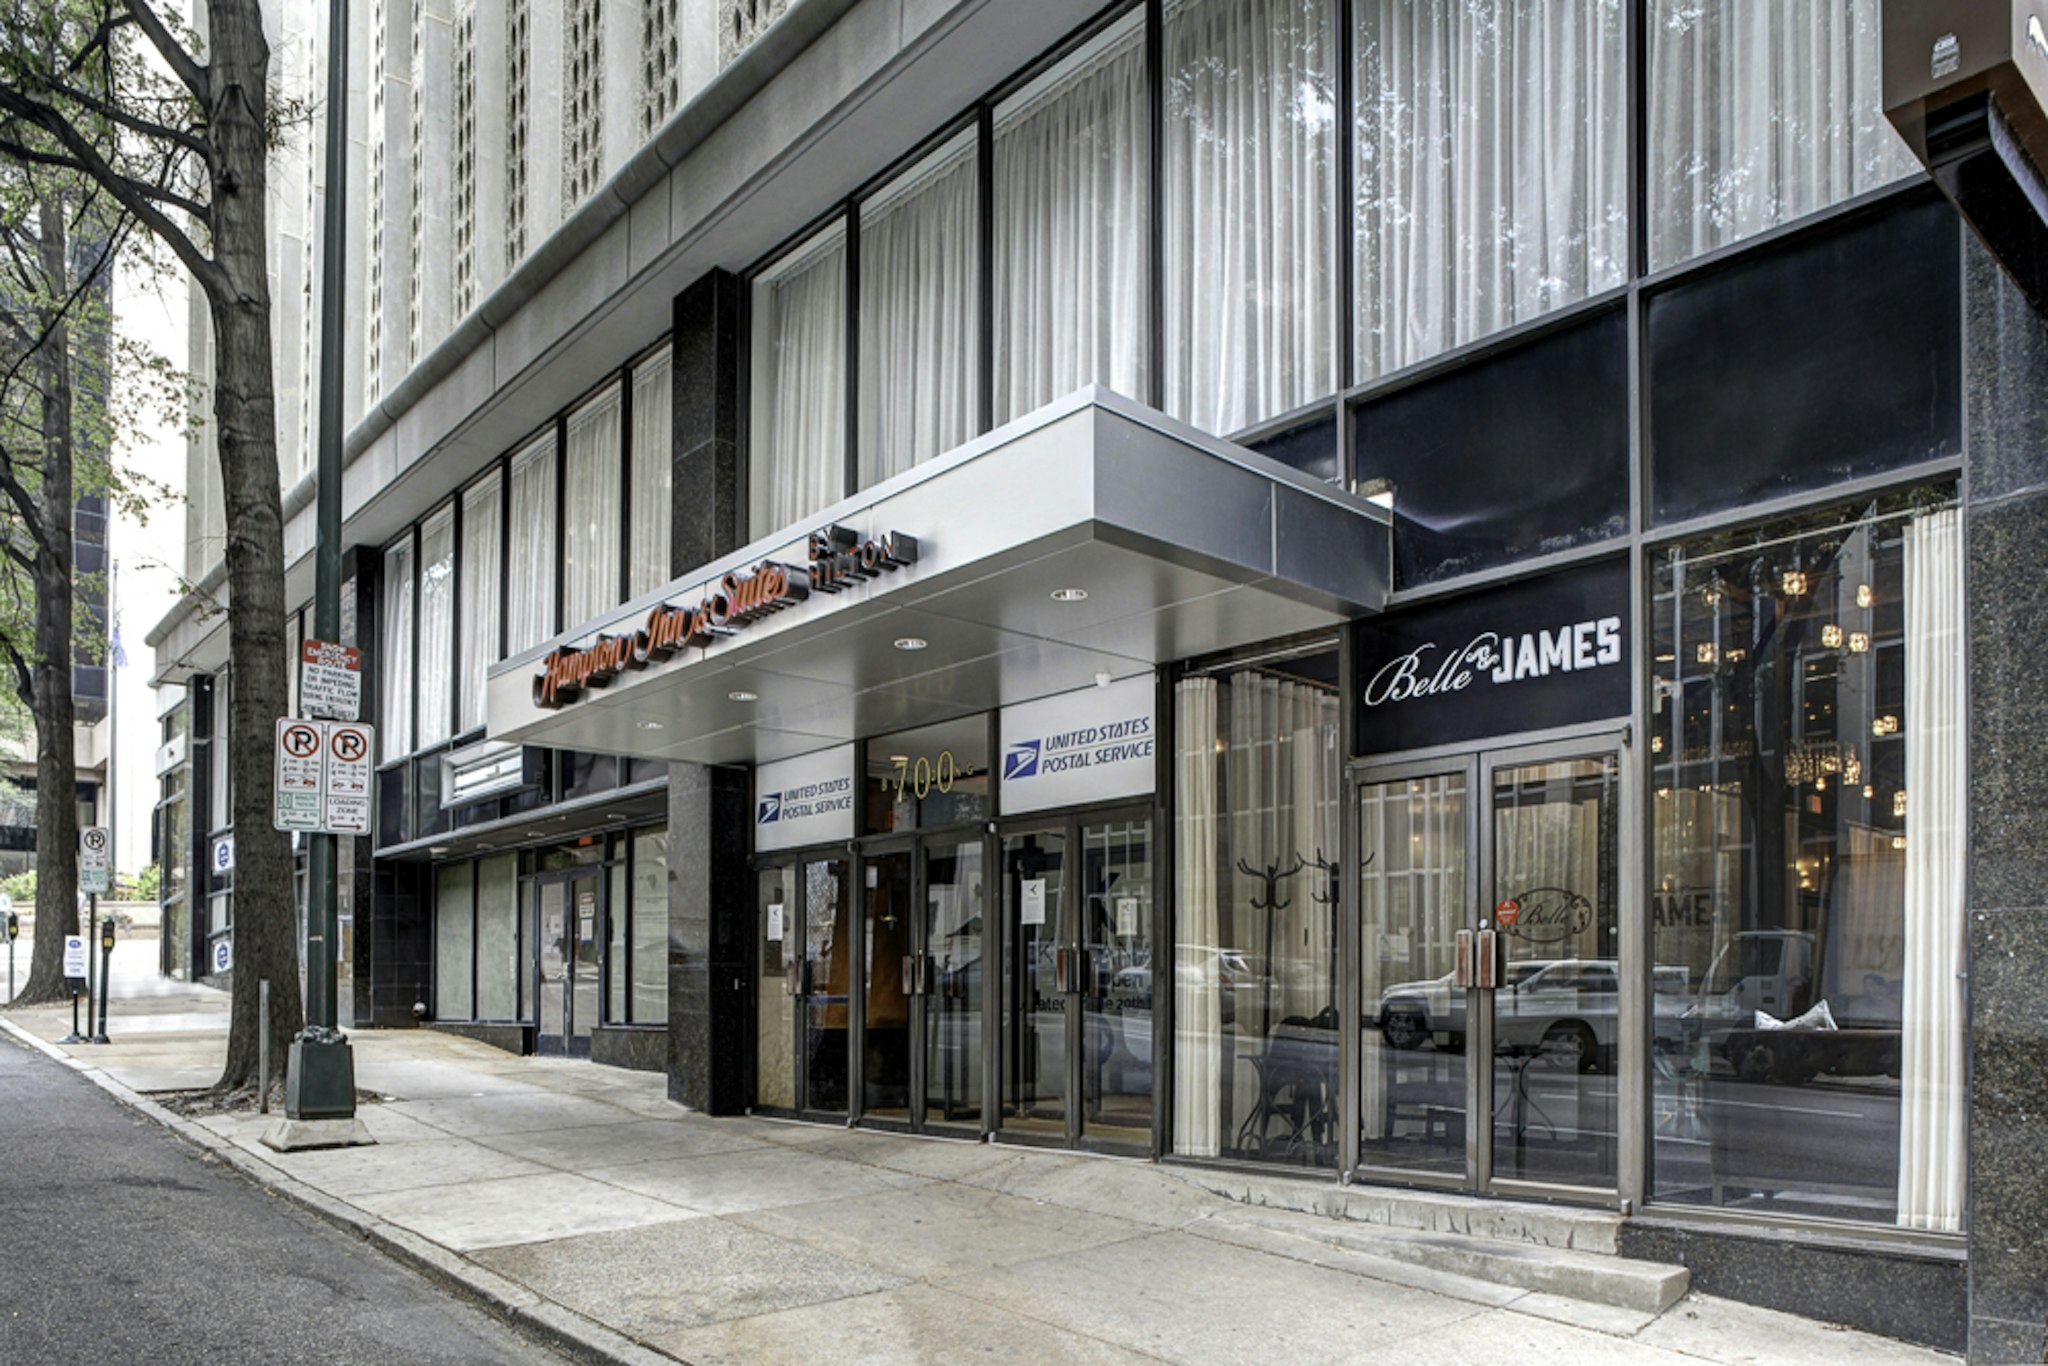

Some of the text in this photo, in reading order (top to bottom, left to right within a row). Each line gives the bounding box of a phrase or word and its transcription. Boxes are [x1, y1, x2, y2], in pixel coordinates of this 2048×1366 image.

[533, 634, 633, 708] Hampton
[634, 602, 694, 661] Inn
[711, 562, 789, 625] Suites
[309, 666, 319, 674] NO
[1365, 616, 1621, 706] Belle & JAMES
[322, 669, 355, 680] PARKING
[304, 683, 334, 694] TRAFFIC
[338, 688, 358, 698] FLOW
[1046, 717, 1149, 751] UNITED STATES
[1042, 739, 1154, 774] POSTAL SERVICE
[890, 751, 953, 803] 700
[784, 778, 850, 801] UNITED STATES
[329, 799, 366, 807] LOADING
[782, 796, 852, 820] POSTAL SERVICE
[1652, 894, 1711, 926] AME
